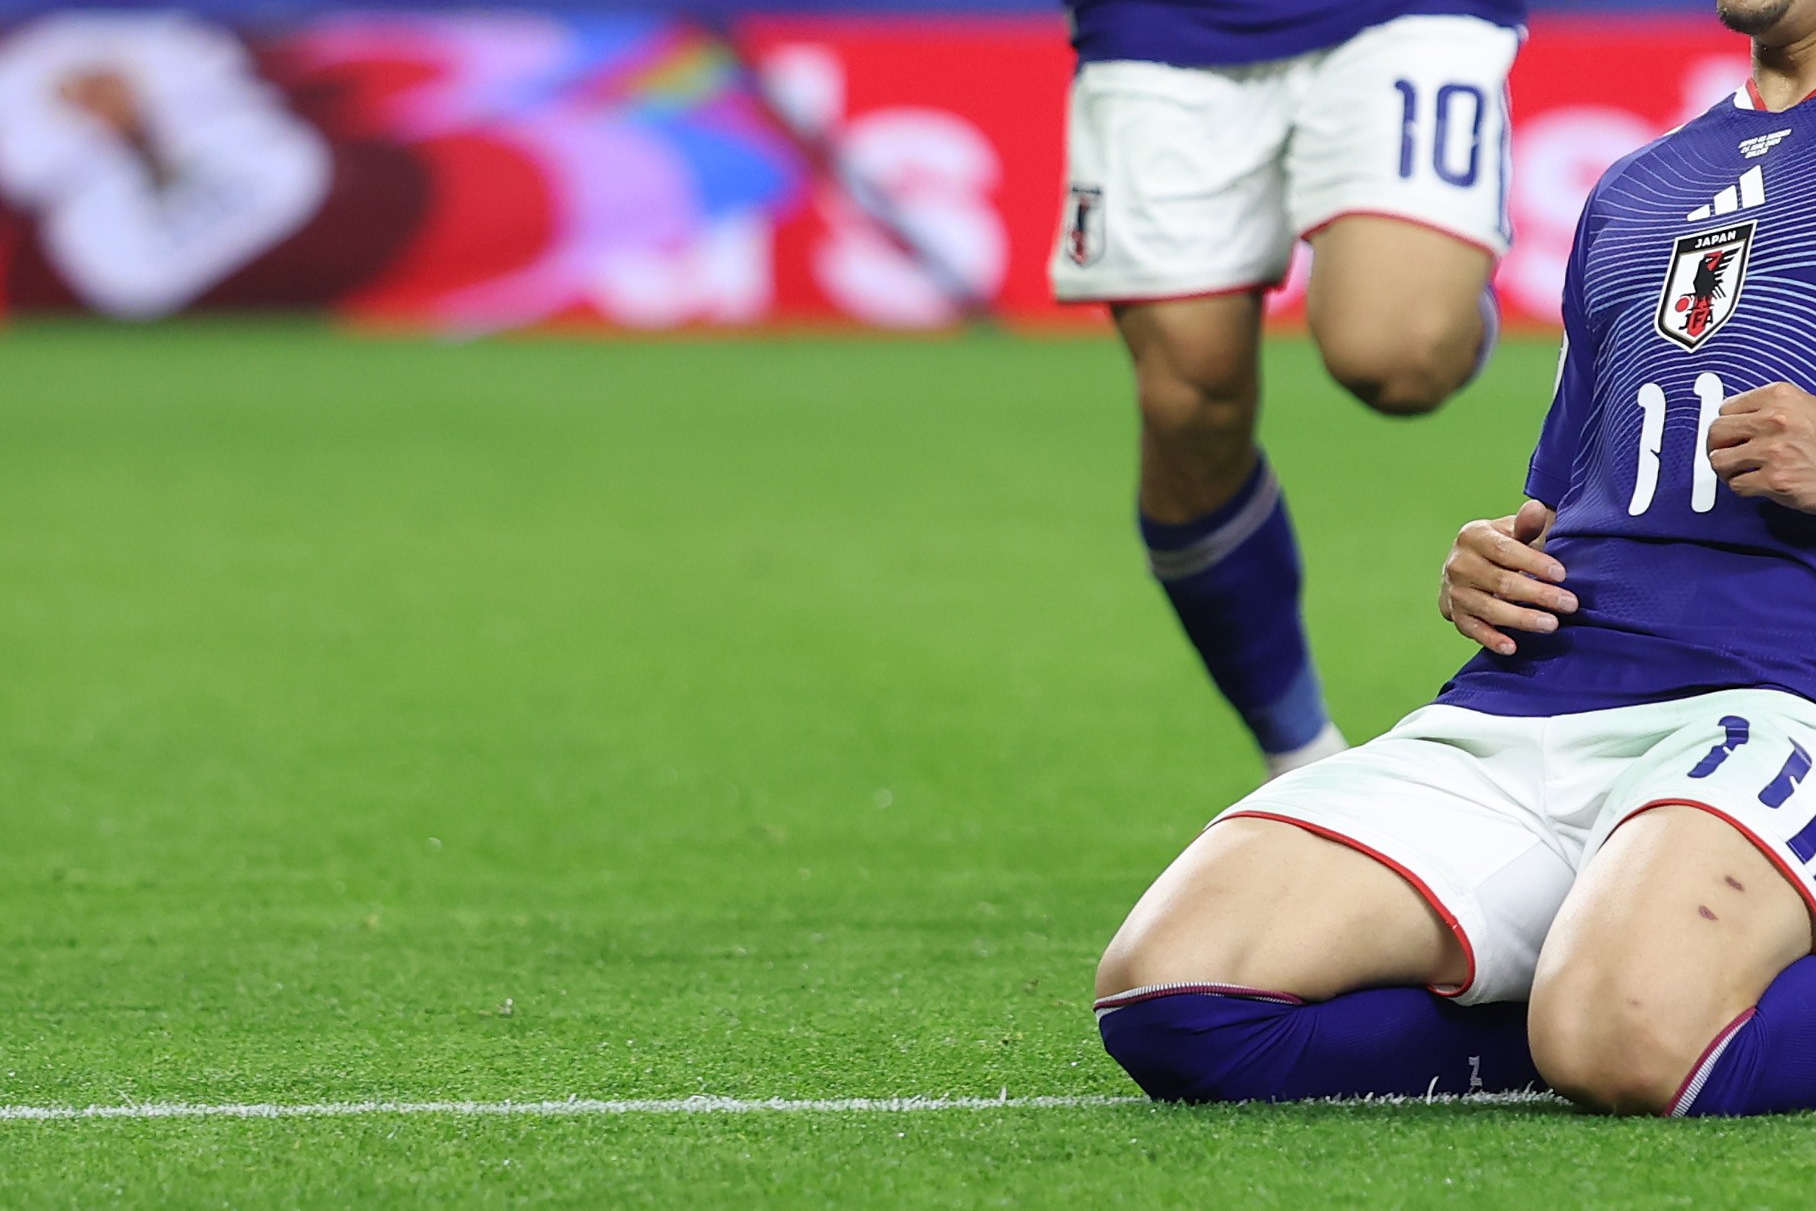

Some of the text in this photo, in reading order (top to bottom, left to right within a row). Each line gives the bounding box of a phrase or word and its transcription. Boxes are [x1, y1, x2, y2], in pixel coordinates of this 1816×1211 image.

[1394, 78, 1484, 187] 10
[1694, 230, 1737, 248] JAPAN
[1678, 308, 1713, 330] JFA
[1628, 372, 1724, 516] 11
